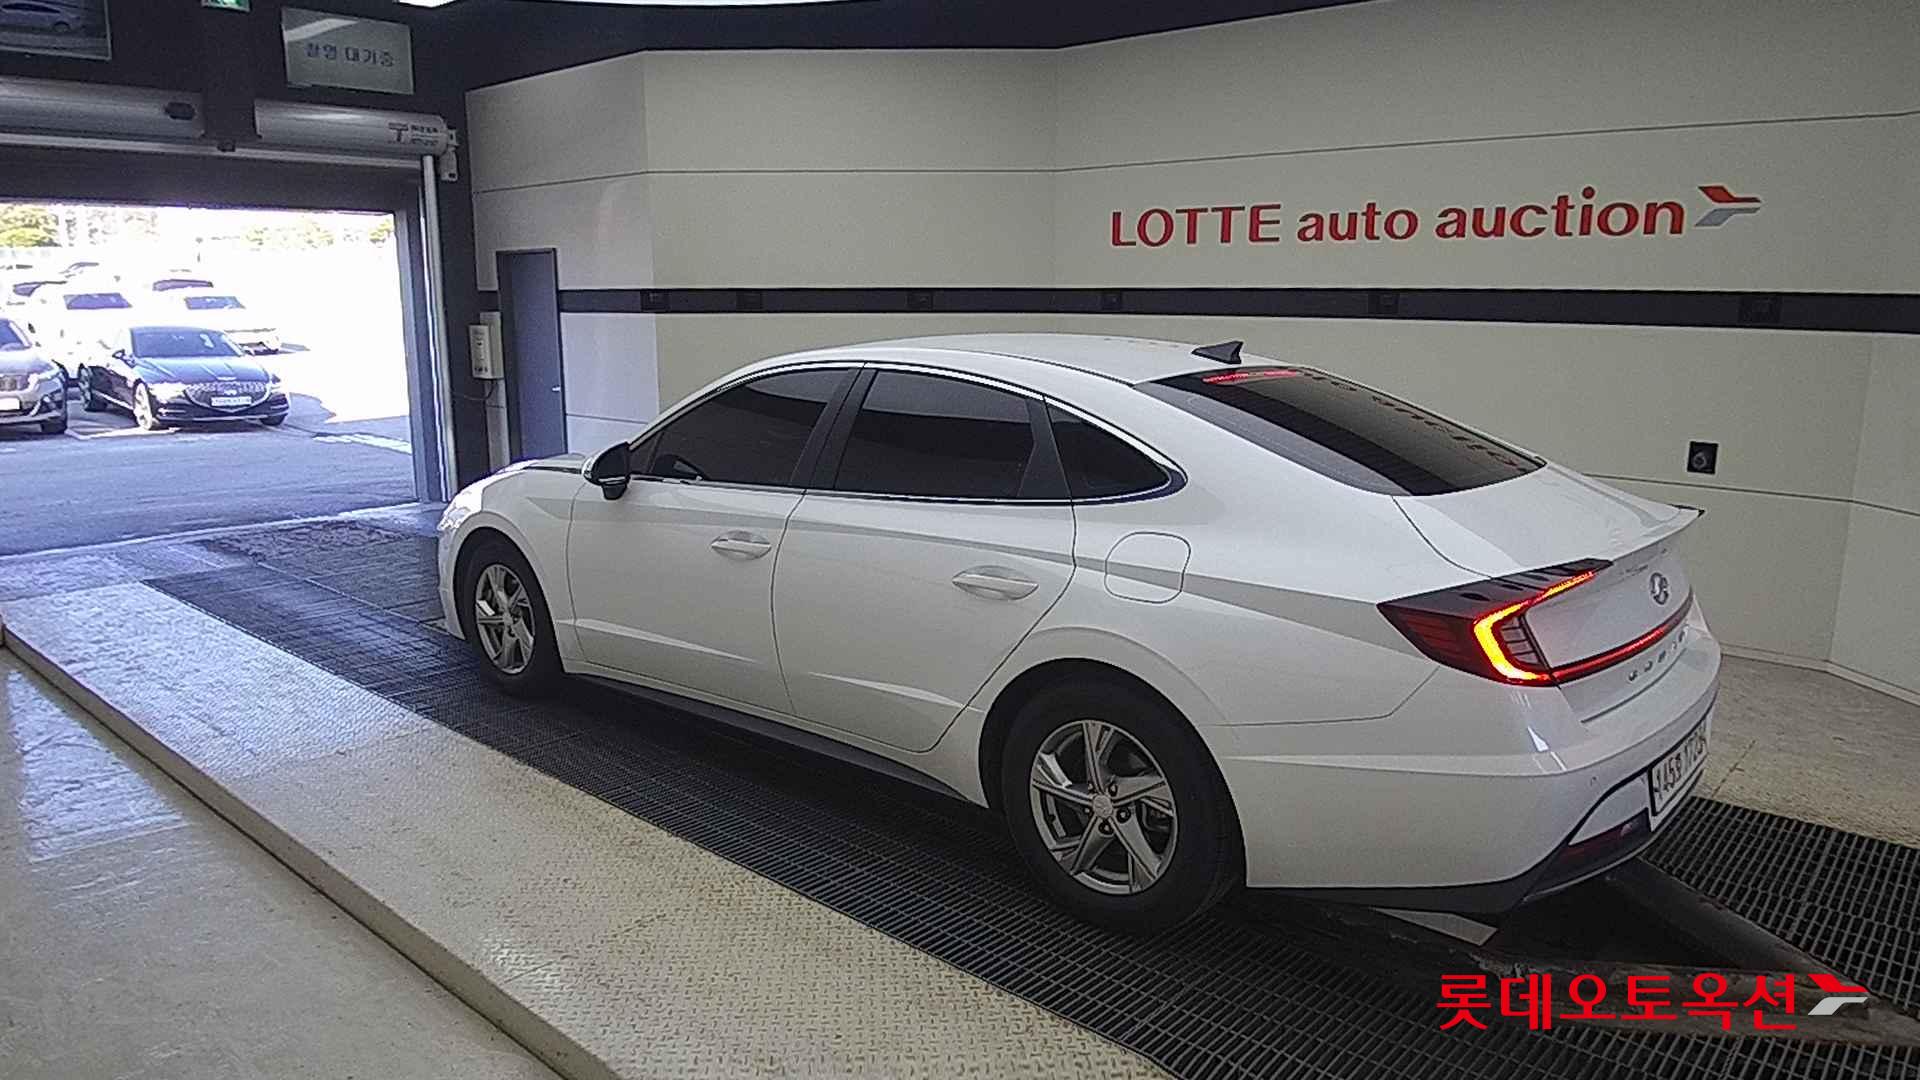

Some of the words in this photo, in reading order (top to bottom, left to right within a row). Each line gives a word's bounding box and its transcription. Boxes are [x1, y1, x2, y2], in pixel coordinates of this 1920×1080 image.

[1112, 204, 1281, 247] LOTTE
[1298, 202, 1419, 242] auto
[1435, 187, 1686, 240] auction
